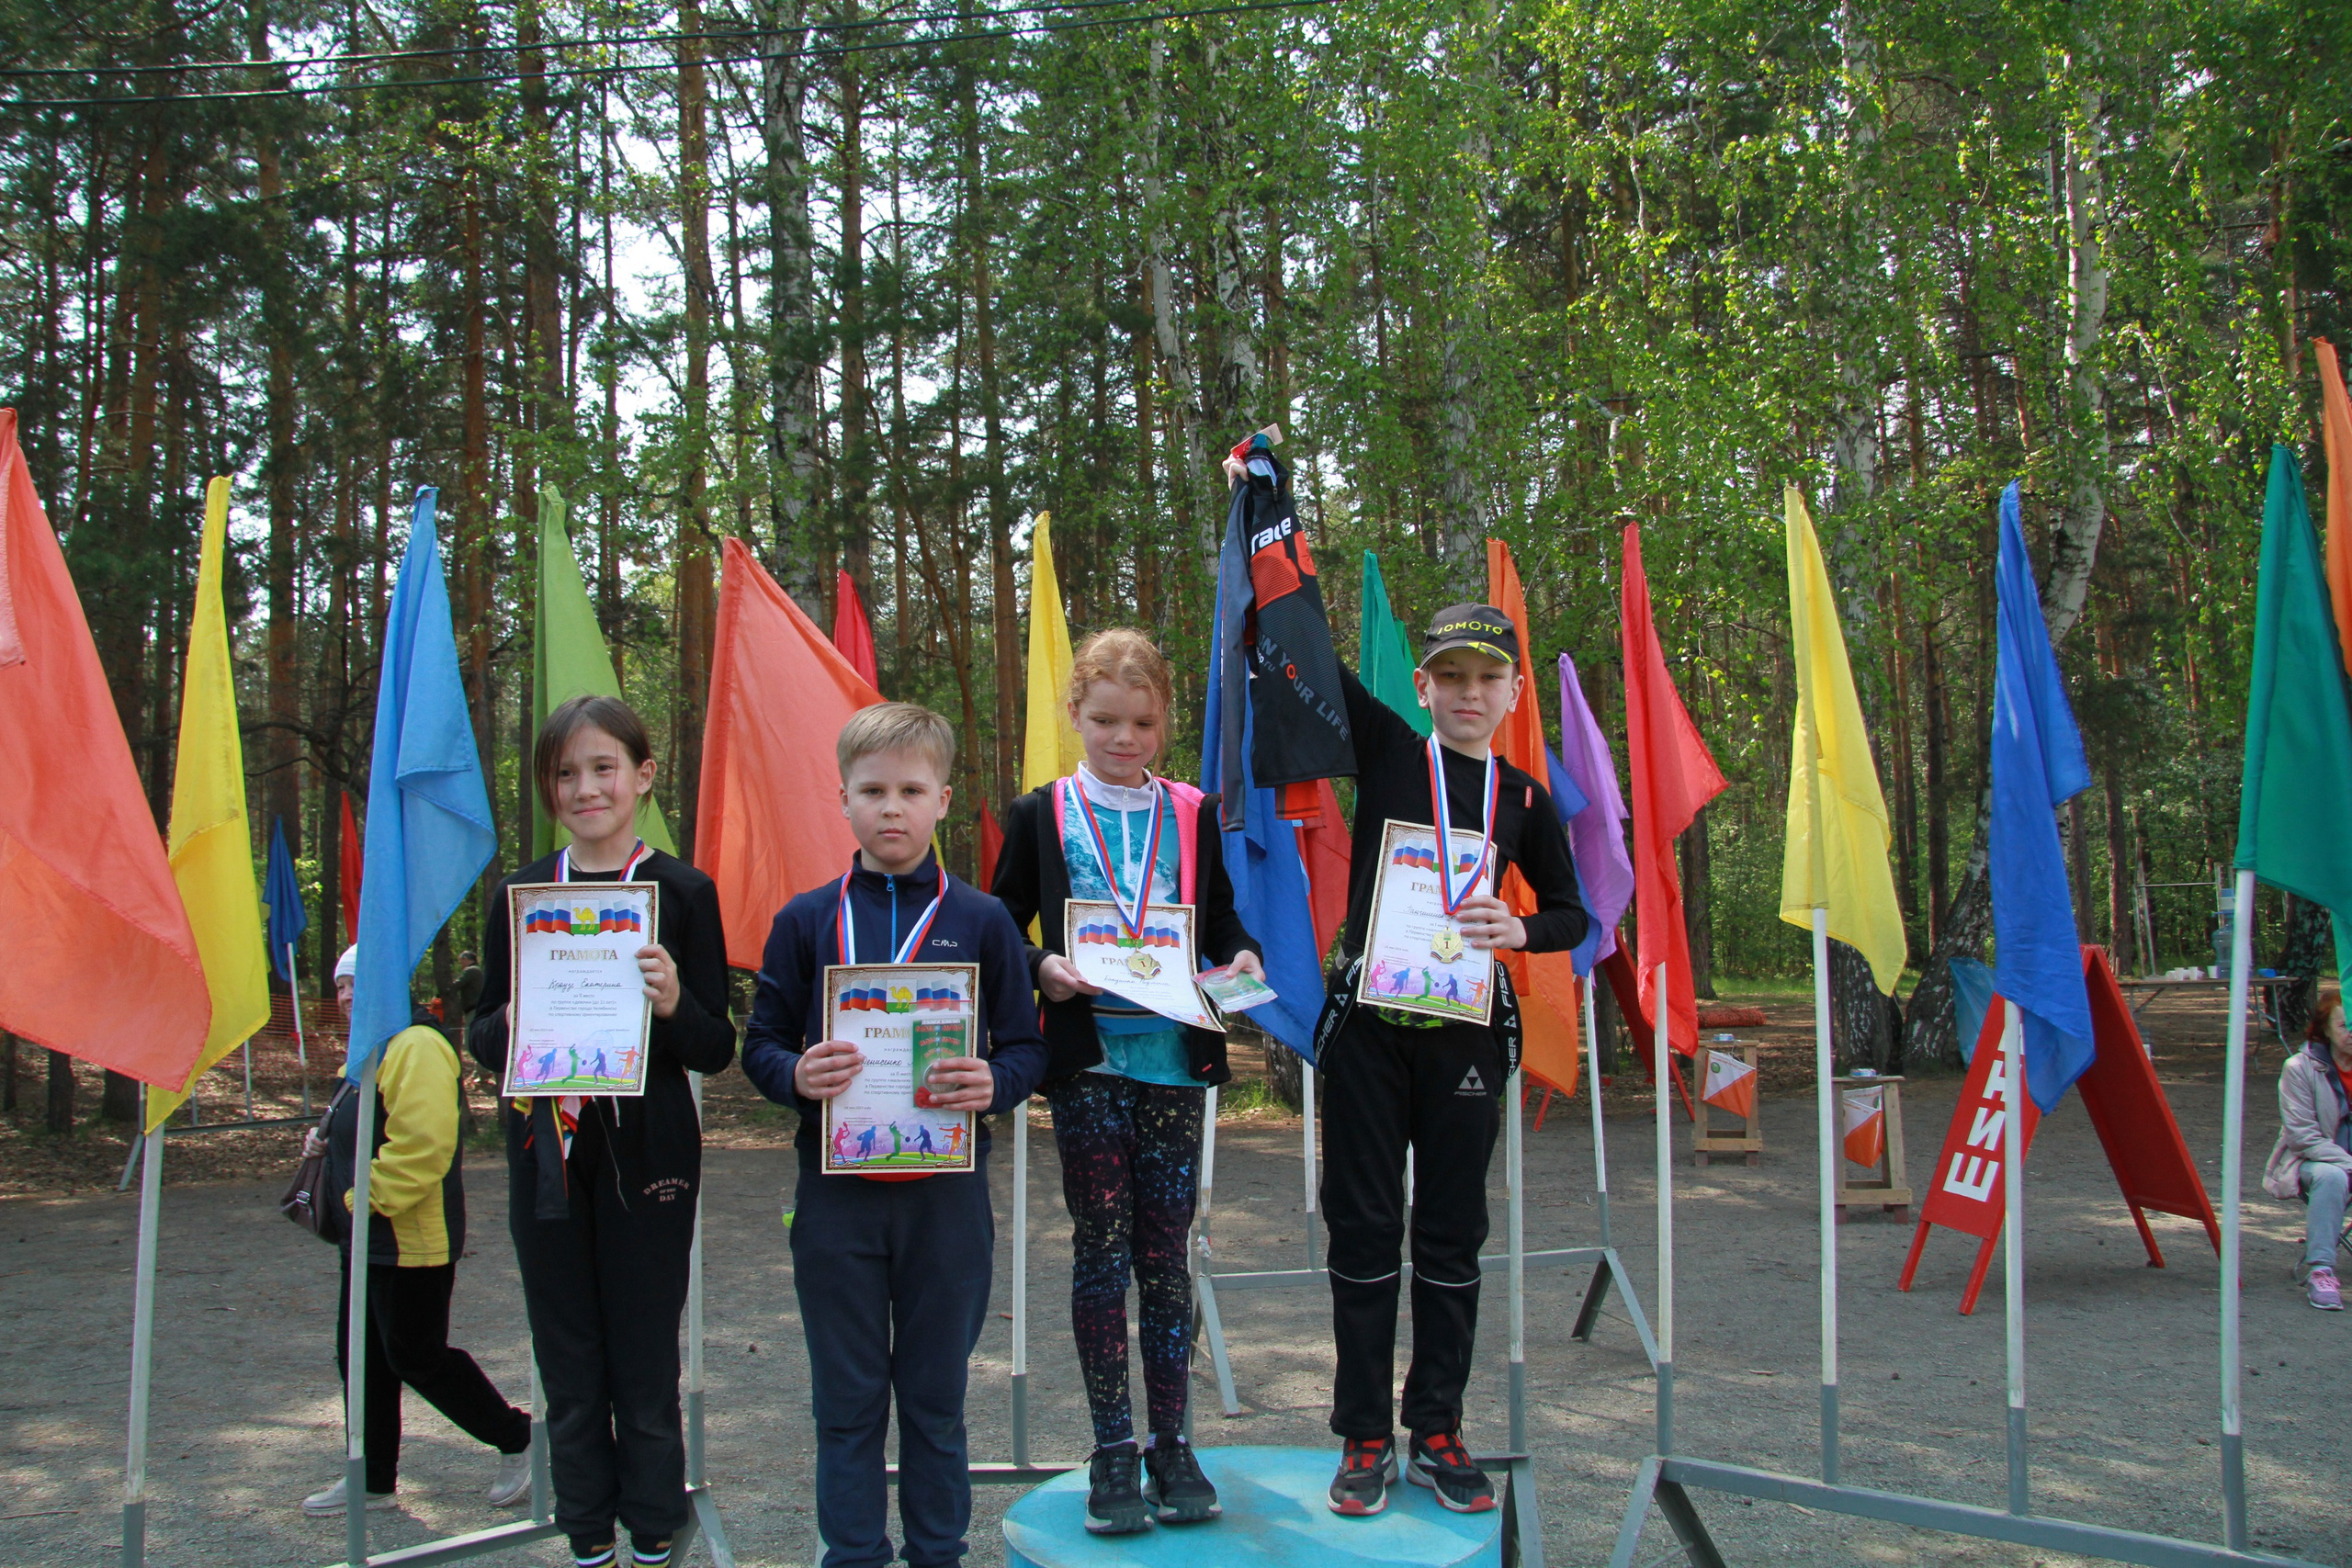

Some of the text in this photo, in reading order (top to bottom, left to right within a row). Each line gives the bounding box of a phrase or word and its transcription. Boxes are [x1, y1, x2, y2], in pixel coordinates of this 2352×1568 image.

[1437, 621, 1502, 635] JOMOTO
[1279, 657, 1316, 705] YOUR
[1317, 701, 1349, 741] LIFE
[932, 939, 958, 947] CMP
[1444, 941, 1449, 949] 1
[550, 949, 618, 961] ГРАМОТА
[642, 1178, 690, 1195] DREAMER
[659, 1193, 676, 1202] DAY
